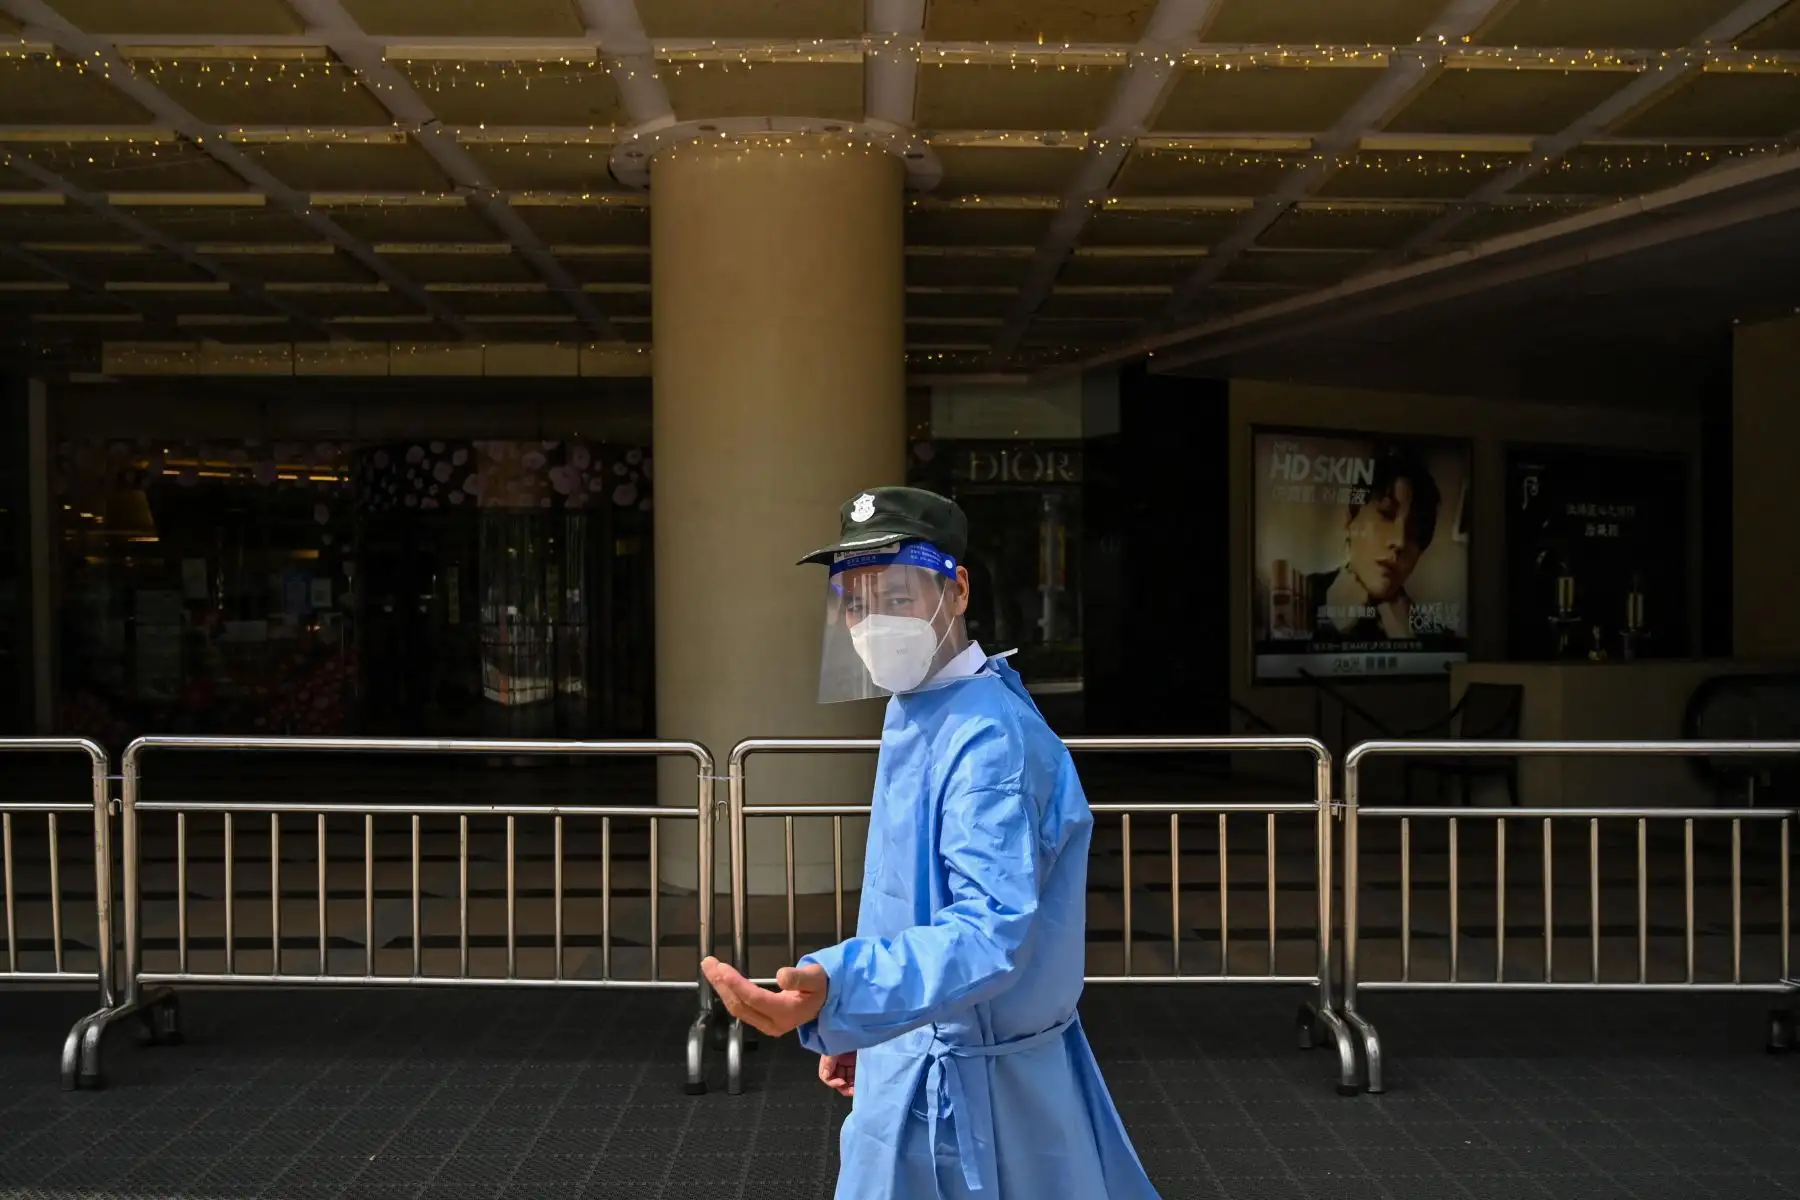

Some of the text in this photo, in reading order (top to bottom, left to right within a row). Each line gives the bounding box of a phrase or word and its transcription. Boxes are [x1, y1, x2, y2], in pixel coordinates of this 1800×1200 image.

[968, 450, 1073, 481] DIOR
[1269, 453, 1376, 485] HD SKIN
[1408, 602, 1442, 615] MAKE
[1408, 615, 1431, 633] FOR
